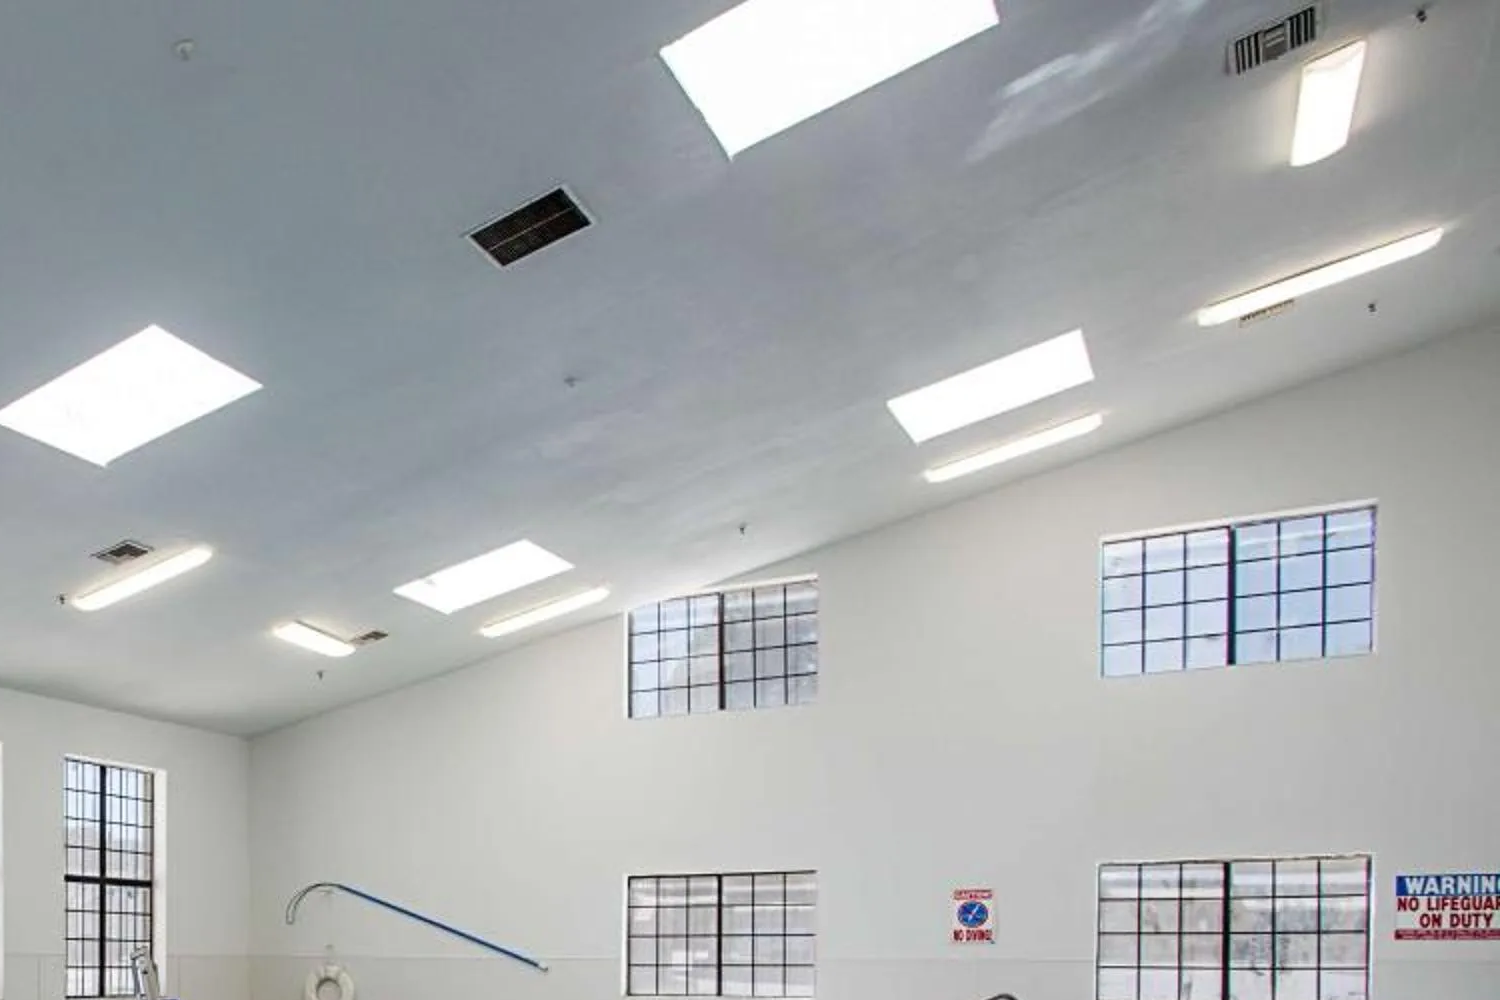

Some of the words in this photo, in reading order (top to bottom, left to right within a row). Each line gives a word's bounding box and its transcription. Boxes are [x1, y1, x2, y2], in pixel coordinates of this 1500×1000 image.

[1405, 875, 1500, 894] WARNIN
[1397, 897, 1419, 912] NO
[1419, 913, 1442, 928] ON
[1450, 913, 1493, 928] DUTY
